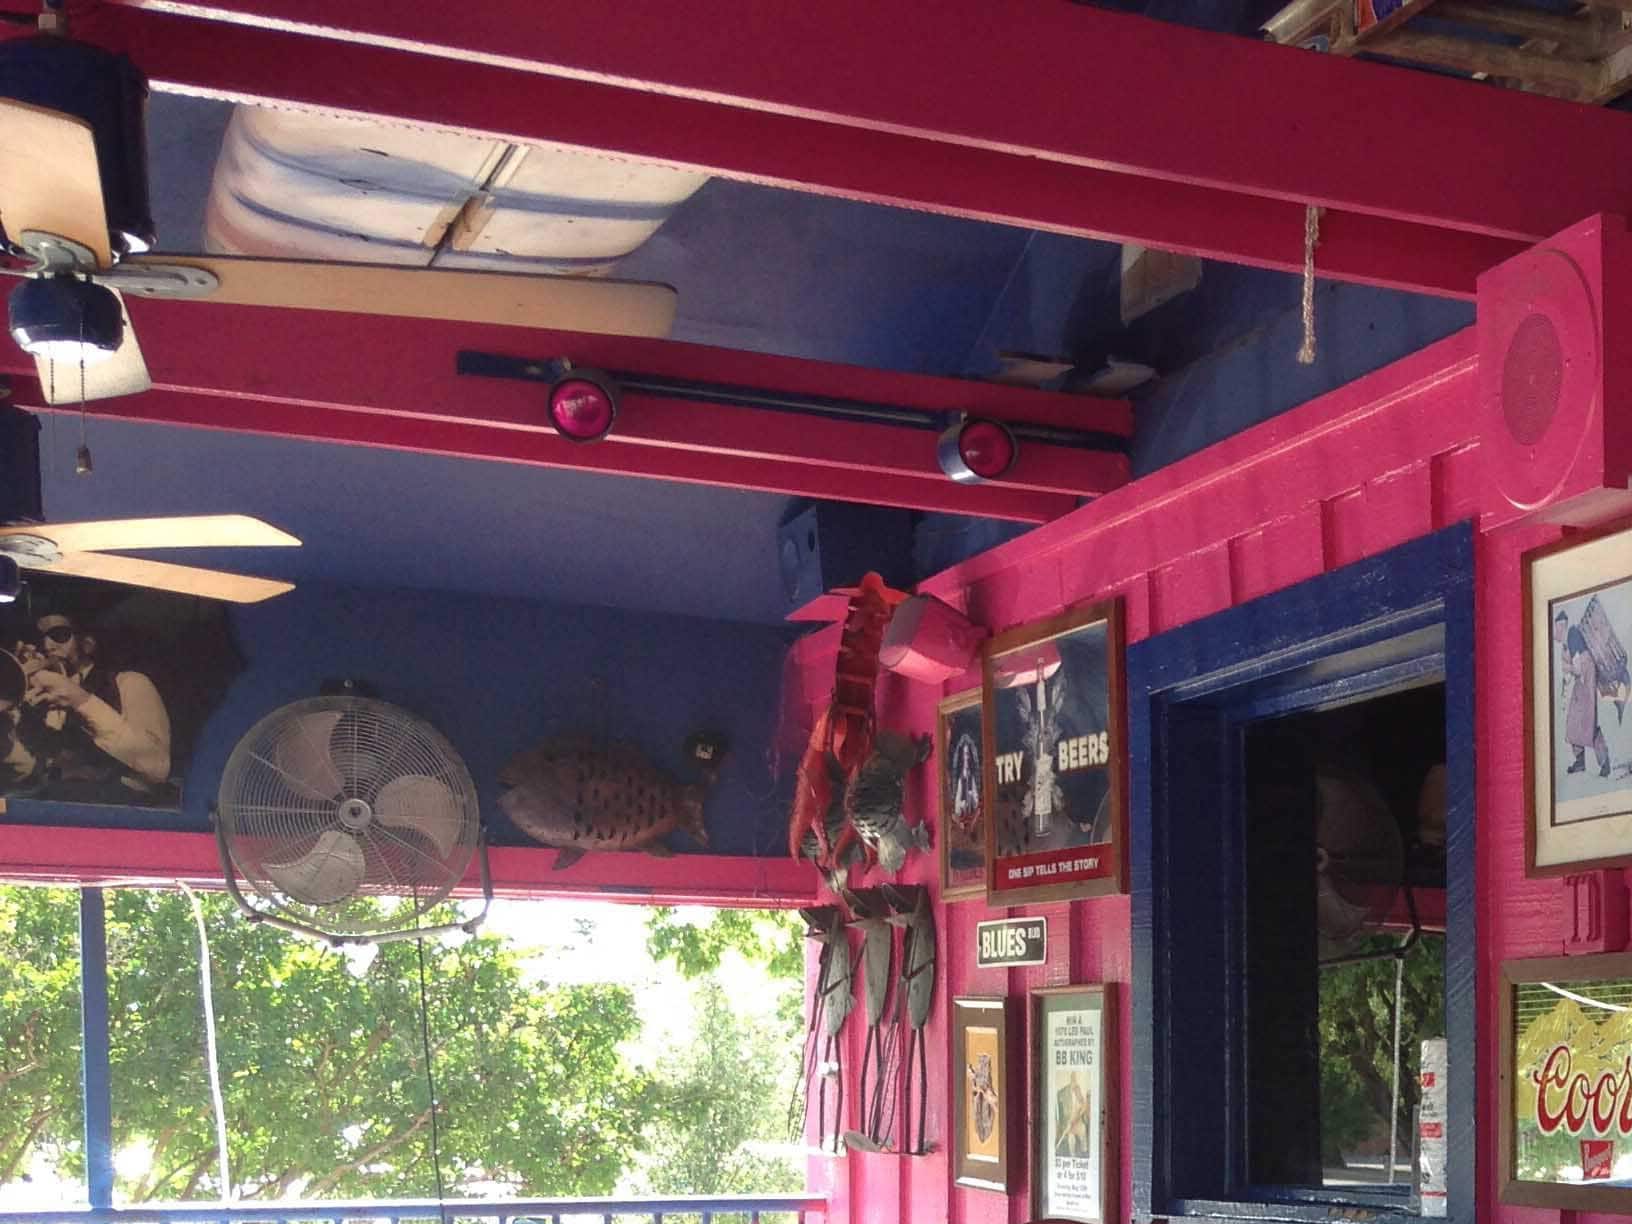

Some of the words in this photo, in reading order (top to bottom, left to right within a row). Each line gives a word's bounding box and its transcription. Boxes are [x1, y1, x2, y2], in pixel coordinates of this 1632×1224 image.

[995, 751, 1024, 785] TRY
[1058, 731, 1109, 772] BEERS
[1008, 867, 1022, 880] ONE
[1035, 863, 1058, 876] TELLS
[1058, 861, 1073, 873] THE
[1074, 857, 1099, 871] STORY
[982, 927, 1027, 959] BLUES
[1056, 1050, 1067, 1065] BB
[1069, 1050, 1093, 1065] KING
[1072, 1159, 1089, 1170] Ticket
